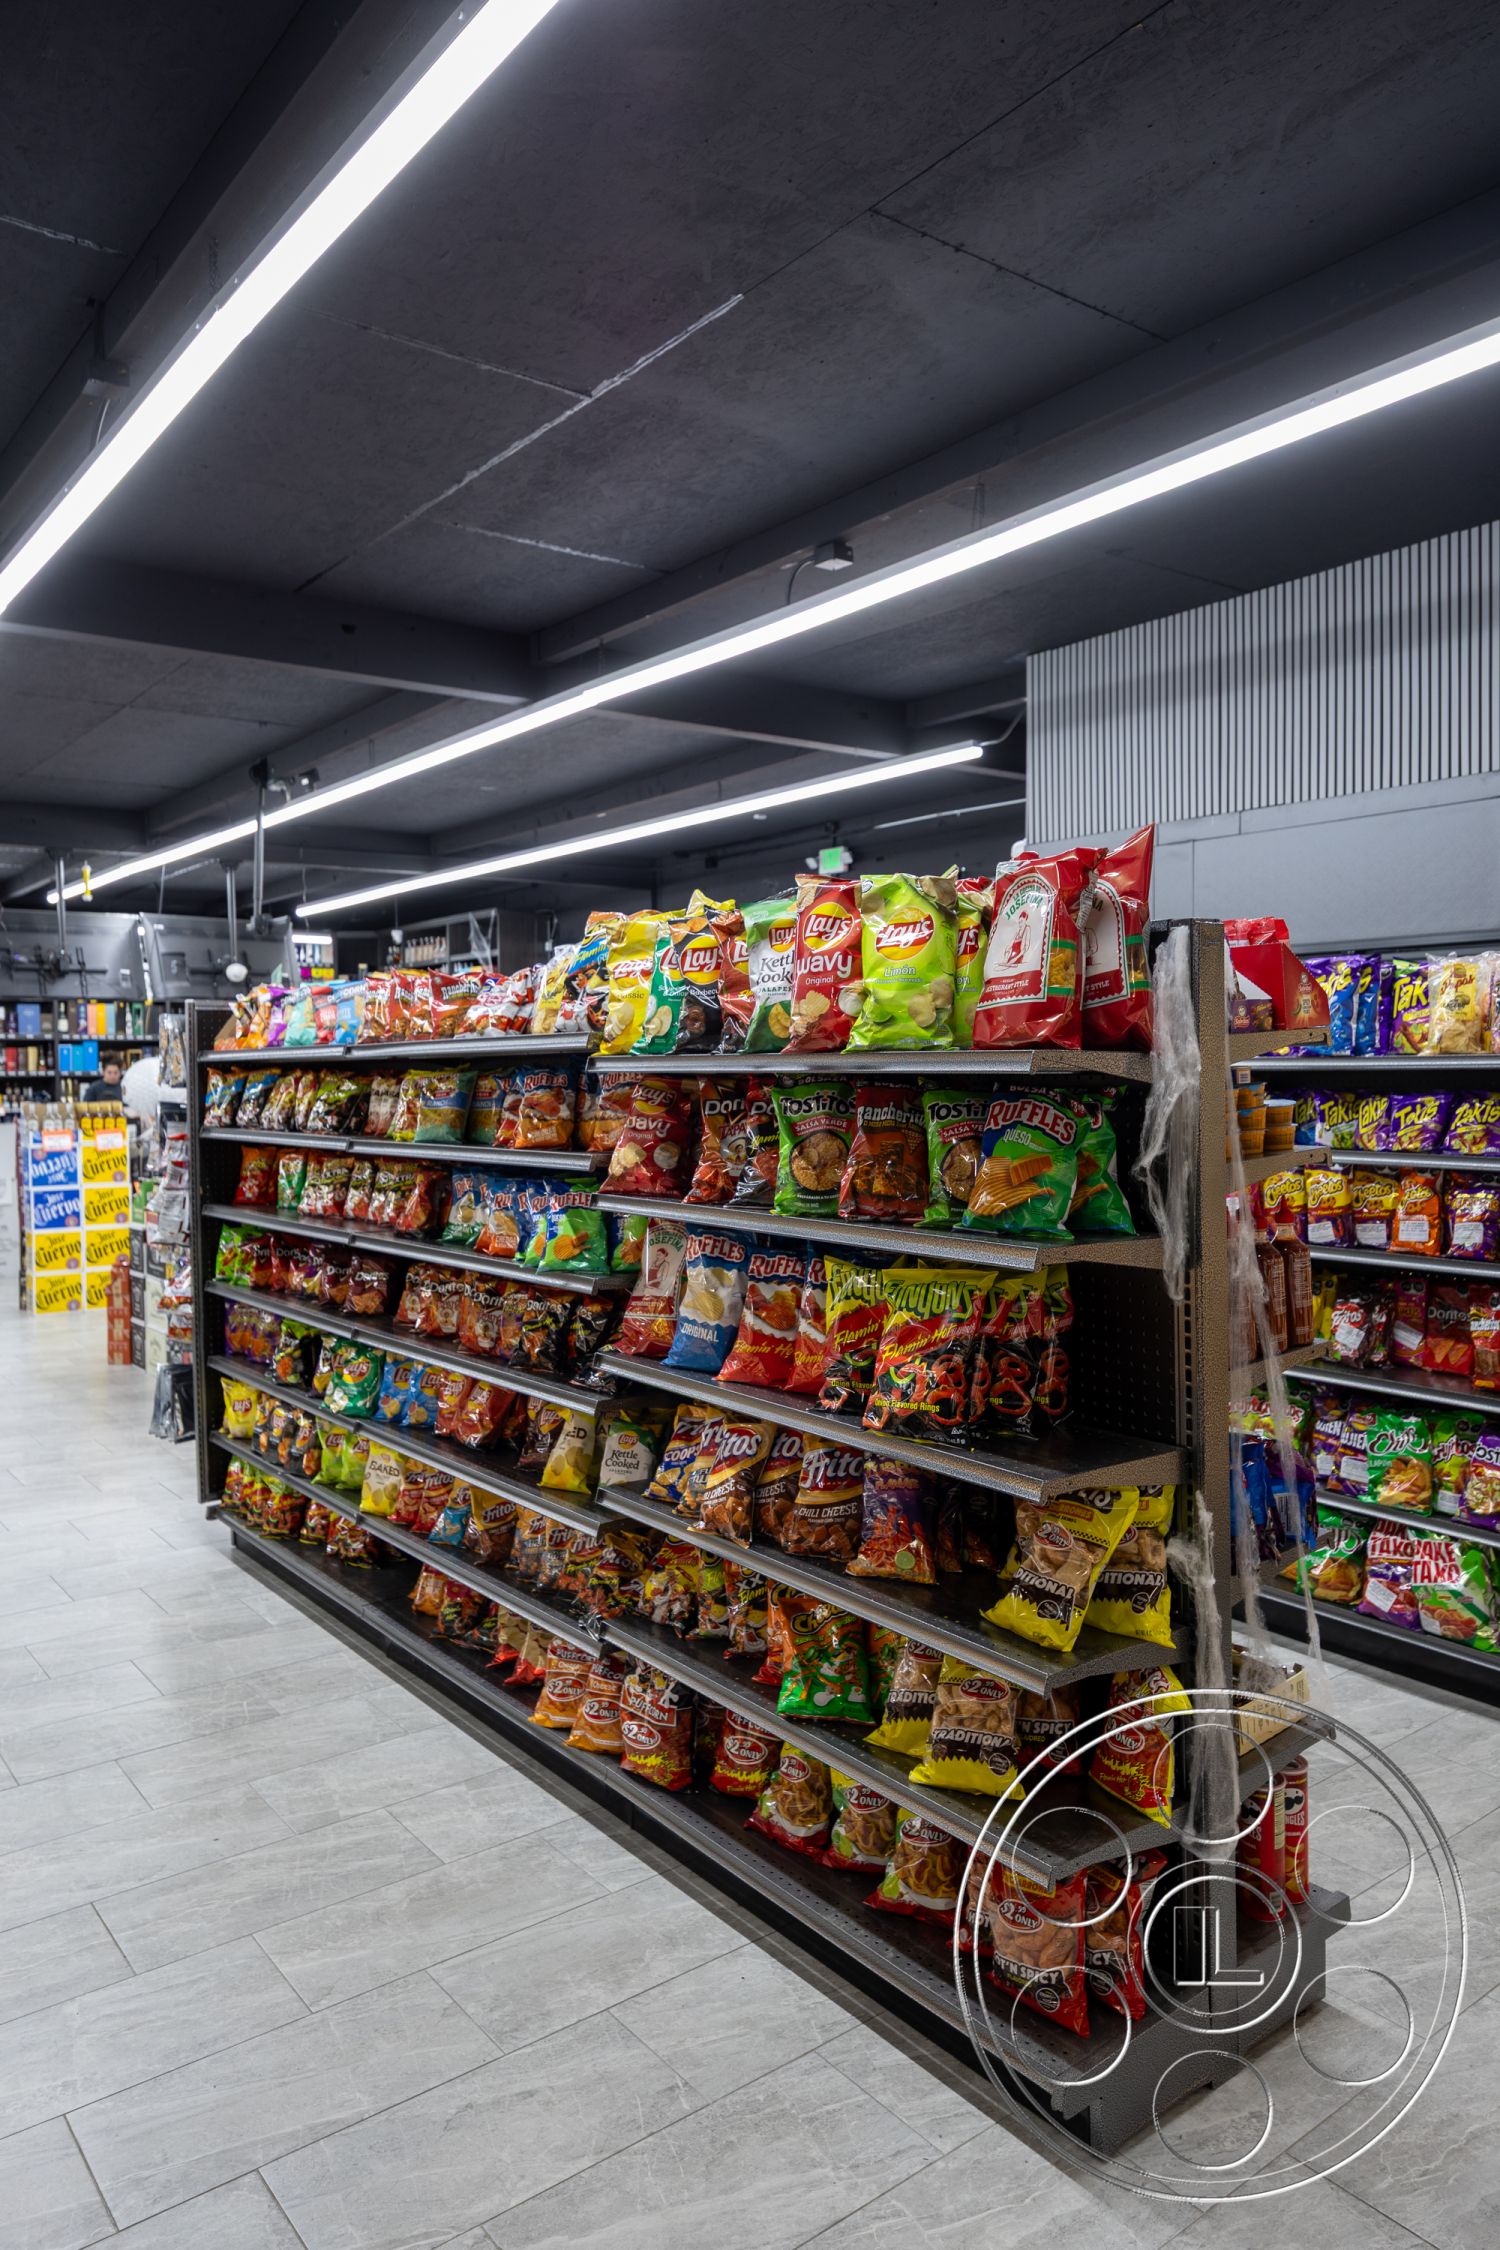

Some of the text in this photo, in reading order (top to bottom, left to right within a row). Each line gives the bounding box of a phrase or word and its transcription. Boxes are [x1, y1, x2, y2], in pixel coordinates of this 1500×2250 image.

[804, 914, 853, 941] Lay's
[877, 912, 934, 948] Lay's
[760, 954, 794, 972] Kettl
[797, 952, 853, 979] wavy
[805, 976, 835, 987] Original
[986, 1099, 1077, 1145] RUFFLES
[1004, 1128, 1031, 1146] QUESO
[550, 1192, 591, 1211] RUFFLE
[686, 1233, 746, 1263] RUFFLES
[830, 1263, 883, 1309] FUNYU
[884, 1278, 977, 1321] FUNYUNS
[680, 1323, 720, 1343] ORIGINAL
[882, 1336, 932, 1362] Flamin'
[891, 1399, 919, 1411] Flavored
[920, 1401, 941, 1413] Rings
[617, 1434, 639, 1447] Lay's
[716, 1428, 762, 1459] itos
[611, 1449, 639, 1460] Kettle
[604, 1458, 640, 1470] Cooked
[799, 1502, 858, 1519] CHILI CHEESE
[1014, 1567, 1075, 1600] DITIONAL
[980, 1687, 1005, 1699] ONLY
[933, 1728, 1014, 1748] TRADITIONA
[740, 1748, 764, 1761] ONLY
[788, 1766, 805, 1778] ONLY
[859, 1796, 883, 1807] ONLY
[921, 1829, 946, 1841] ONLY
[1014, 1915, 1038, 1929] ONLY
[1020, 1965, 1060, 1985] SPICY
